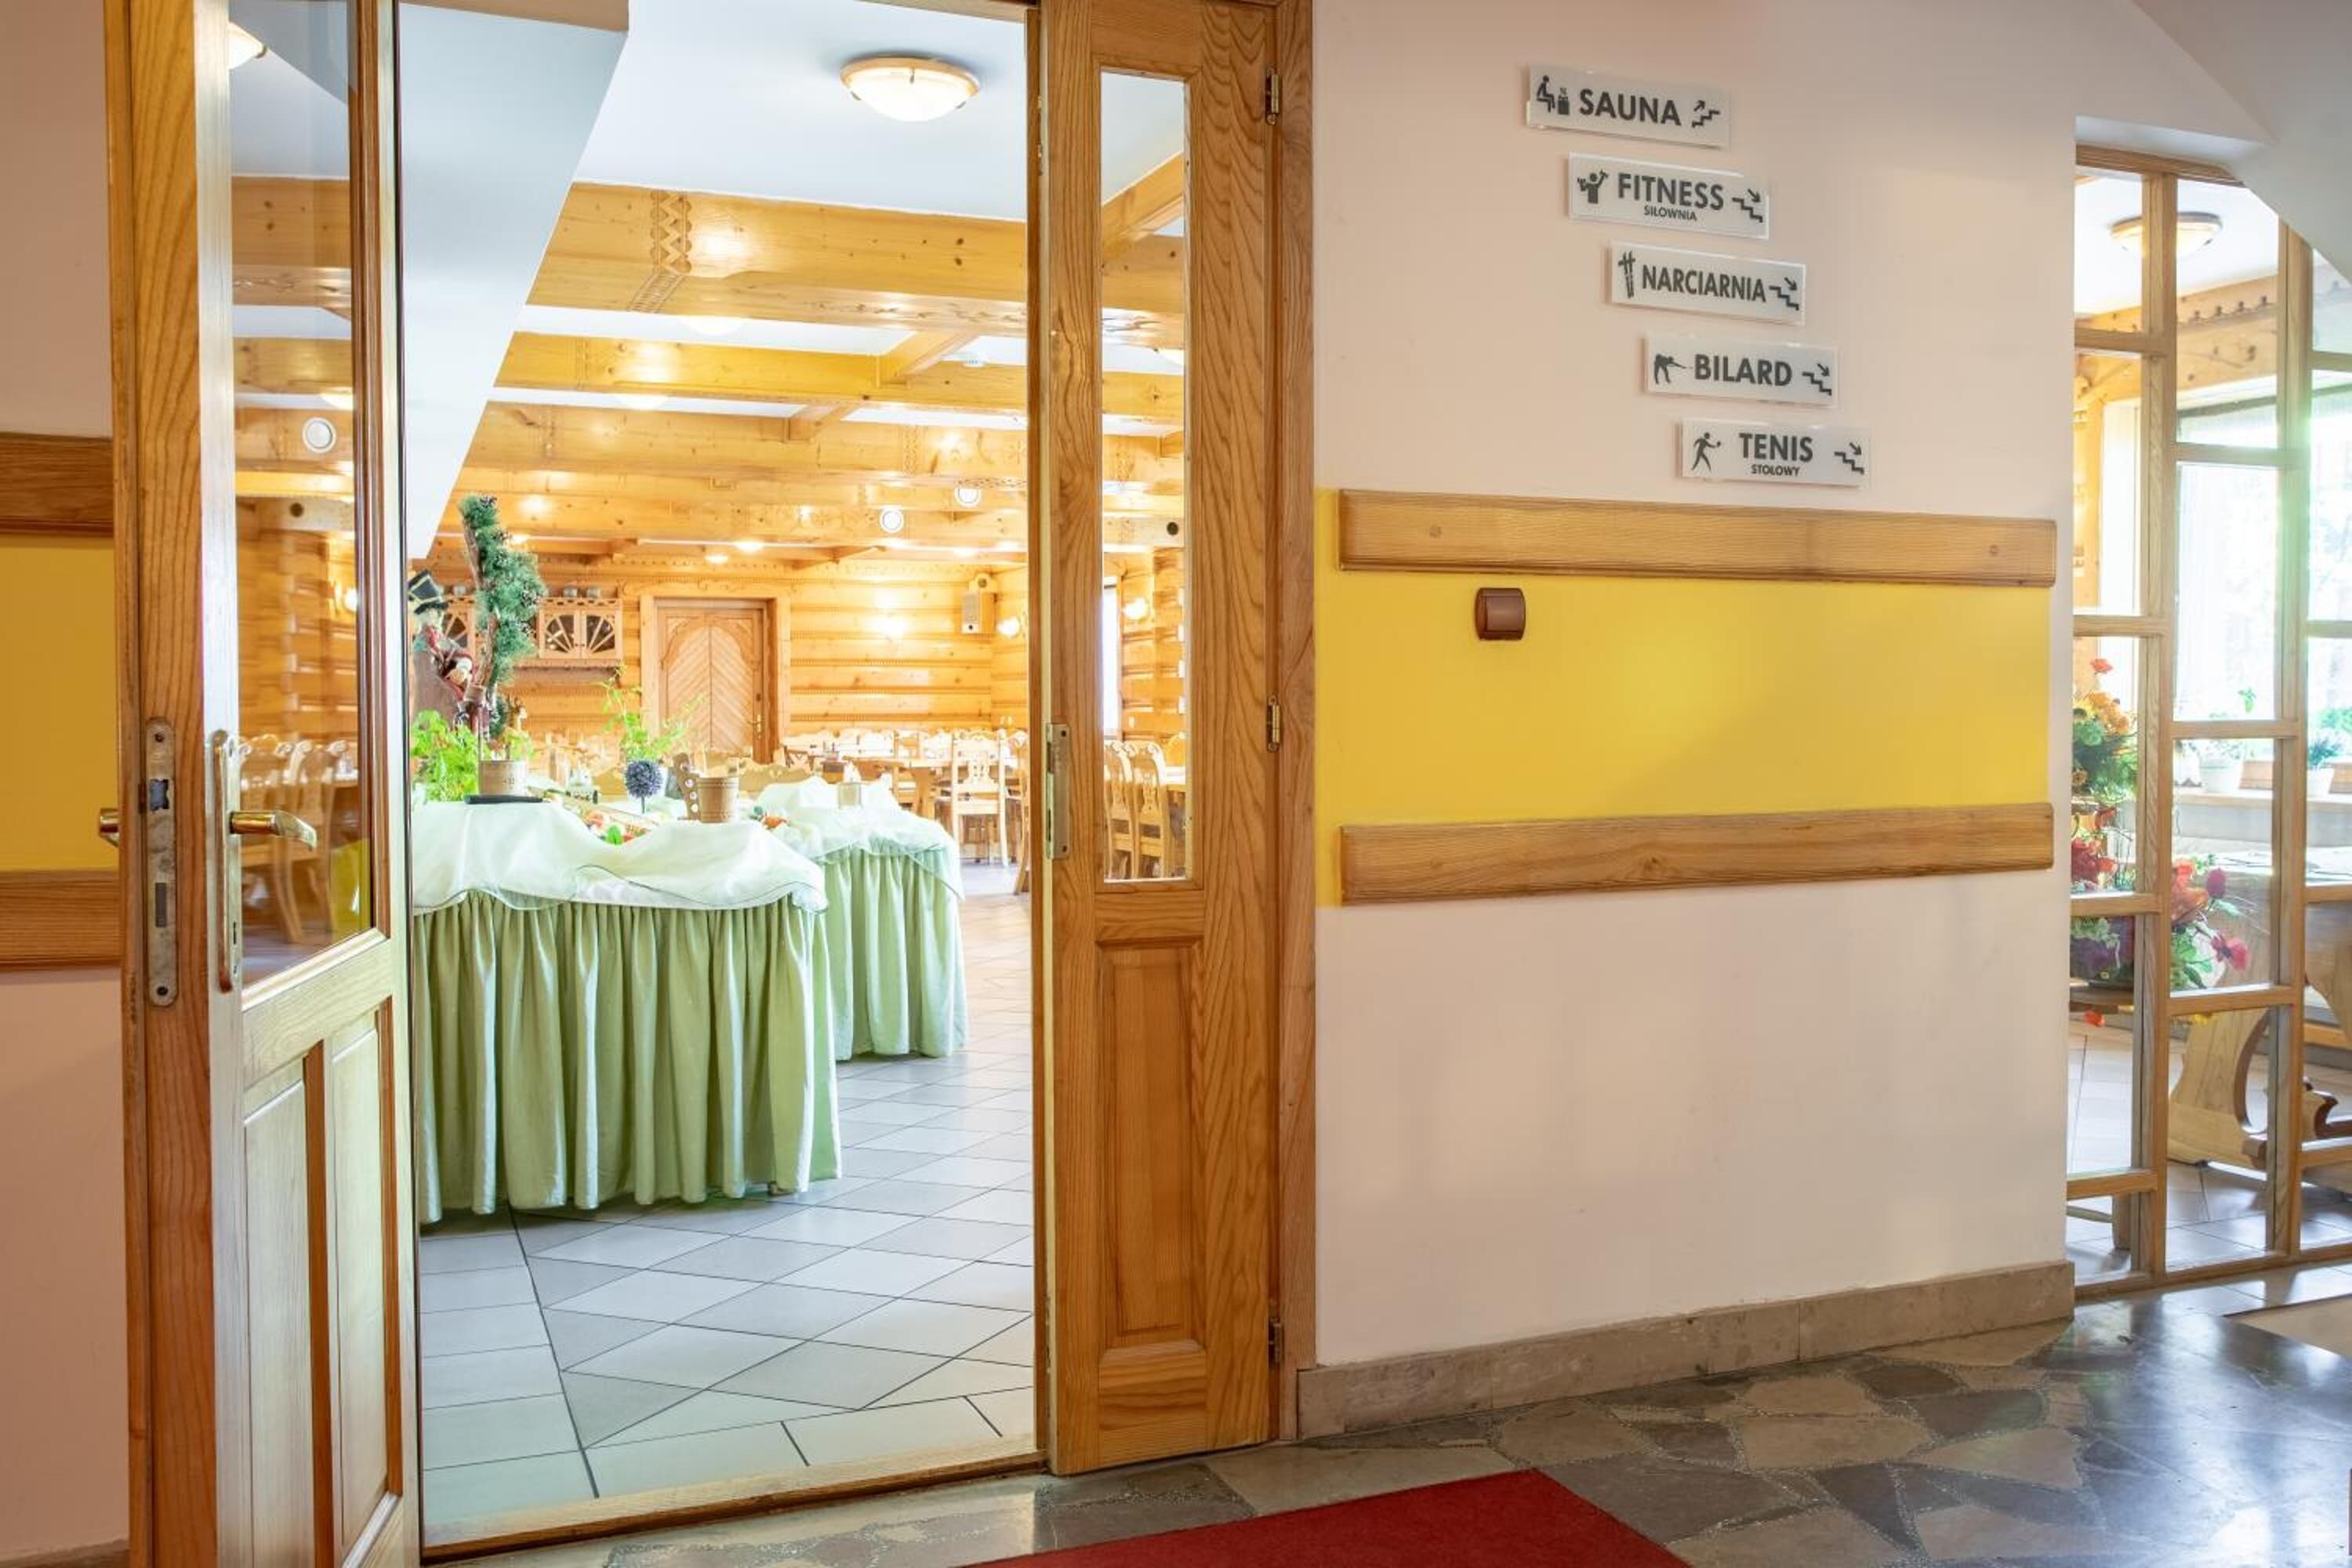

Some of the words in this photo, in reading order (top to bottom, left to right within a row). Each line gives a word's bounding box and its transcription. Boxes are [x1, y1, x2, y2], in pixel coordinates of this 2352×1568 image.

[1580, 89, 1681, 125] SAUNA
[1617, 172, 1724, 210] FITNESS
[1642, 265, 1766, 303] NARCIARNIA
[1694, 354, 1792, 387] BILARD
[1739, 433, 1813, 462] TENIS
